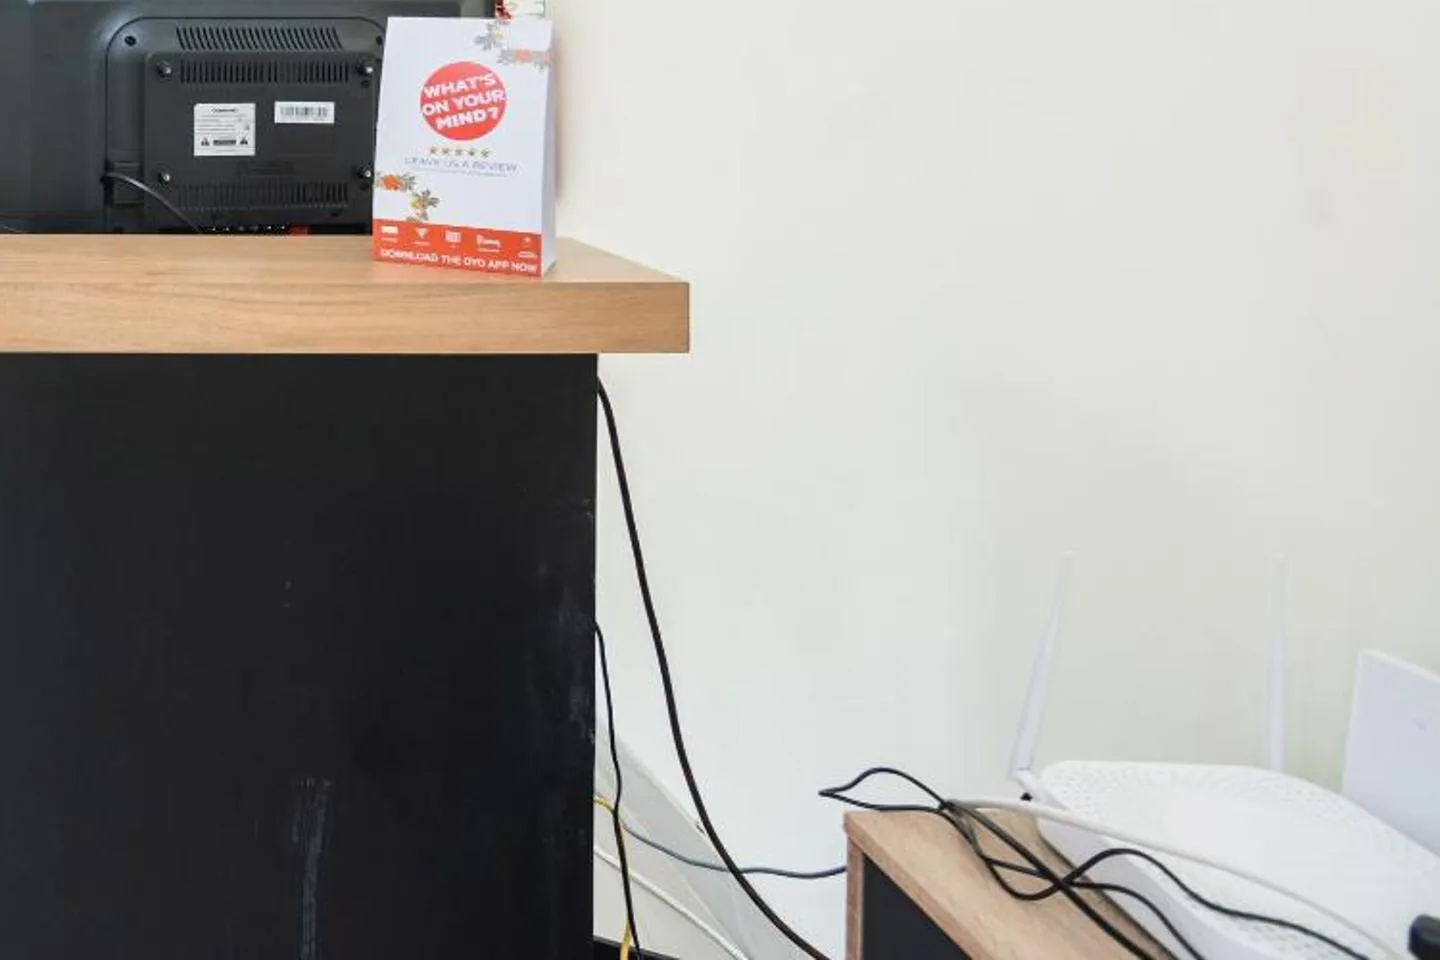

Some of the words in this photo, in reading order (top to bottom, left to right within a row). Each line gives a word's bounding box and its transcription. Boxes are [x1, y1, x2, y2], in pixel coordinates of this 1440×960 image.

[423, 73, 497, 99] WHAT'S
[422, 99, 450, 116] ON
[451, 89, 506, 110] YOUR
[435, 106, 499, 130] MIND?
[380, 247, 439, 263] DOWNLOAD
[441, 254, 460, 266] THE
[463, 257, 486, 268] OYO
[488, 260, 510, 270] APP
[511, 262, 538, 274] NOW
